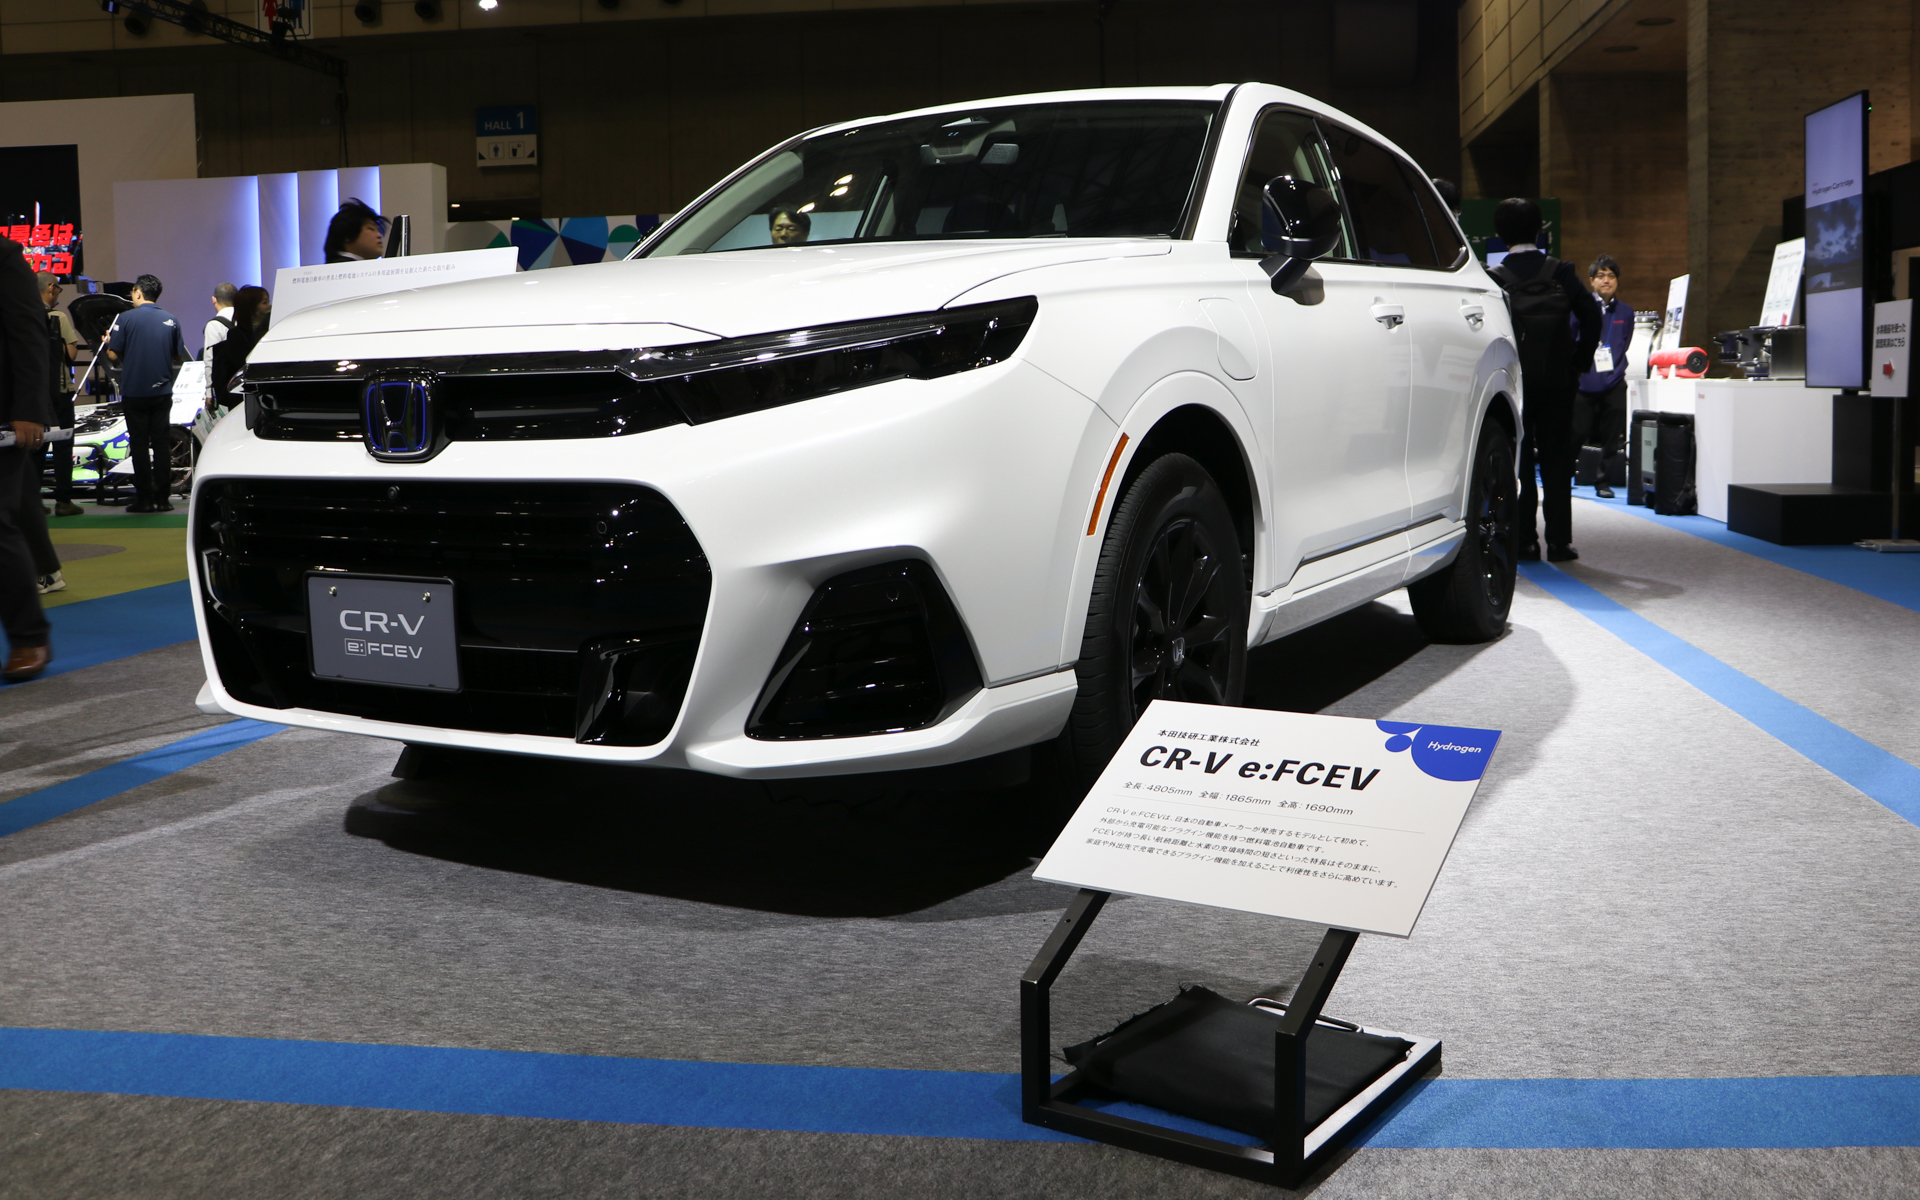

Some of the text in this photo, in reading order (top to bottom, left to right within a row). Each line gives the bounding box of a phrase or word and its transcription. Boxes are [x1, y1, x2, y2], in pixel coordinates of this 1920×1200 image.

[484, 111, 524, 130] HALL 1
[340, 609, 425, 636] CR-V
[345, 639, 423, 659] e:FCEV
[1157, 729, 1261, 747] 本田技研工業株式会社
[1427, 740, 1482, 754] Hydrogen
[1140, 745, 1381, 791] CR-V e:FCEV
[1099, 817, 1325, 854] 外部から充電可能なプラグイン機能を持つ燃料電池自動車です。
